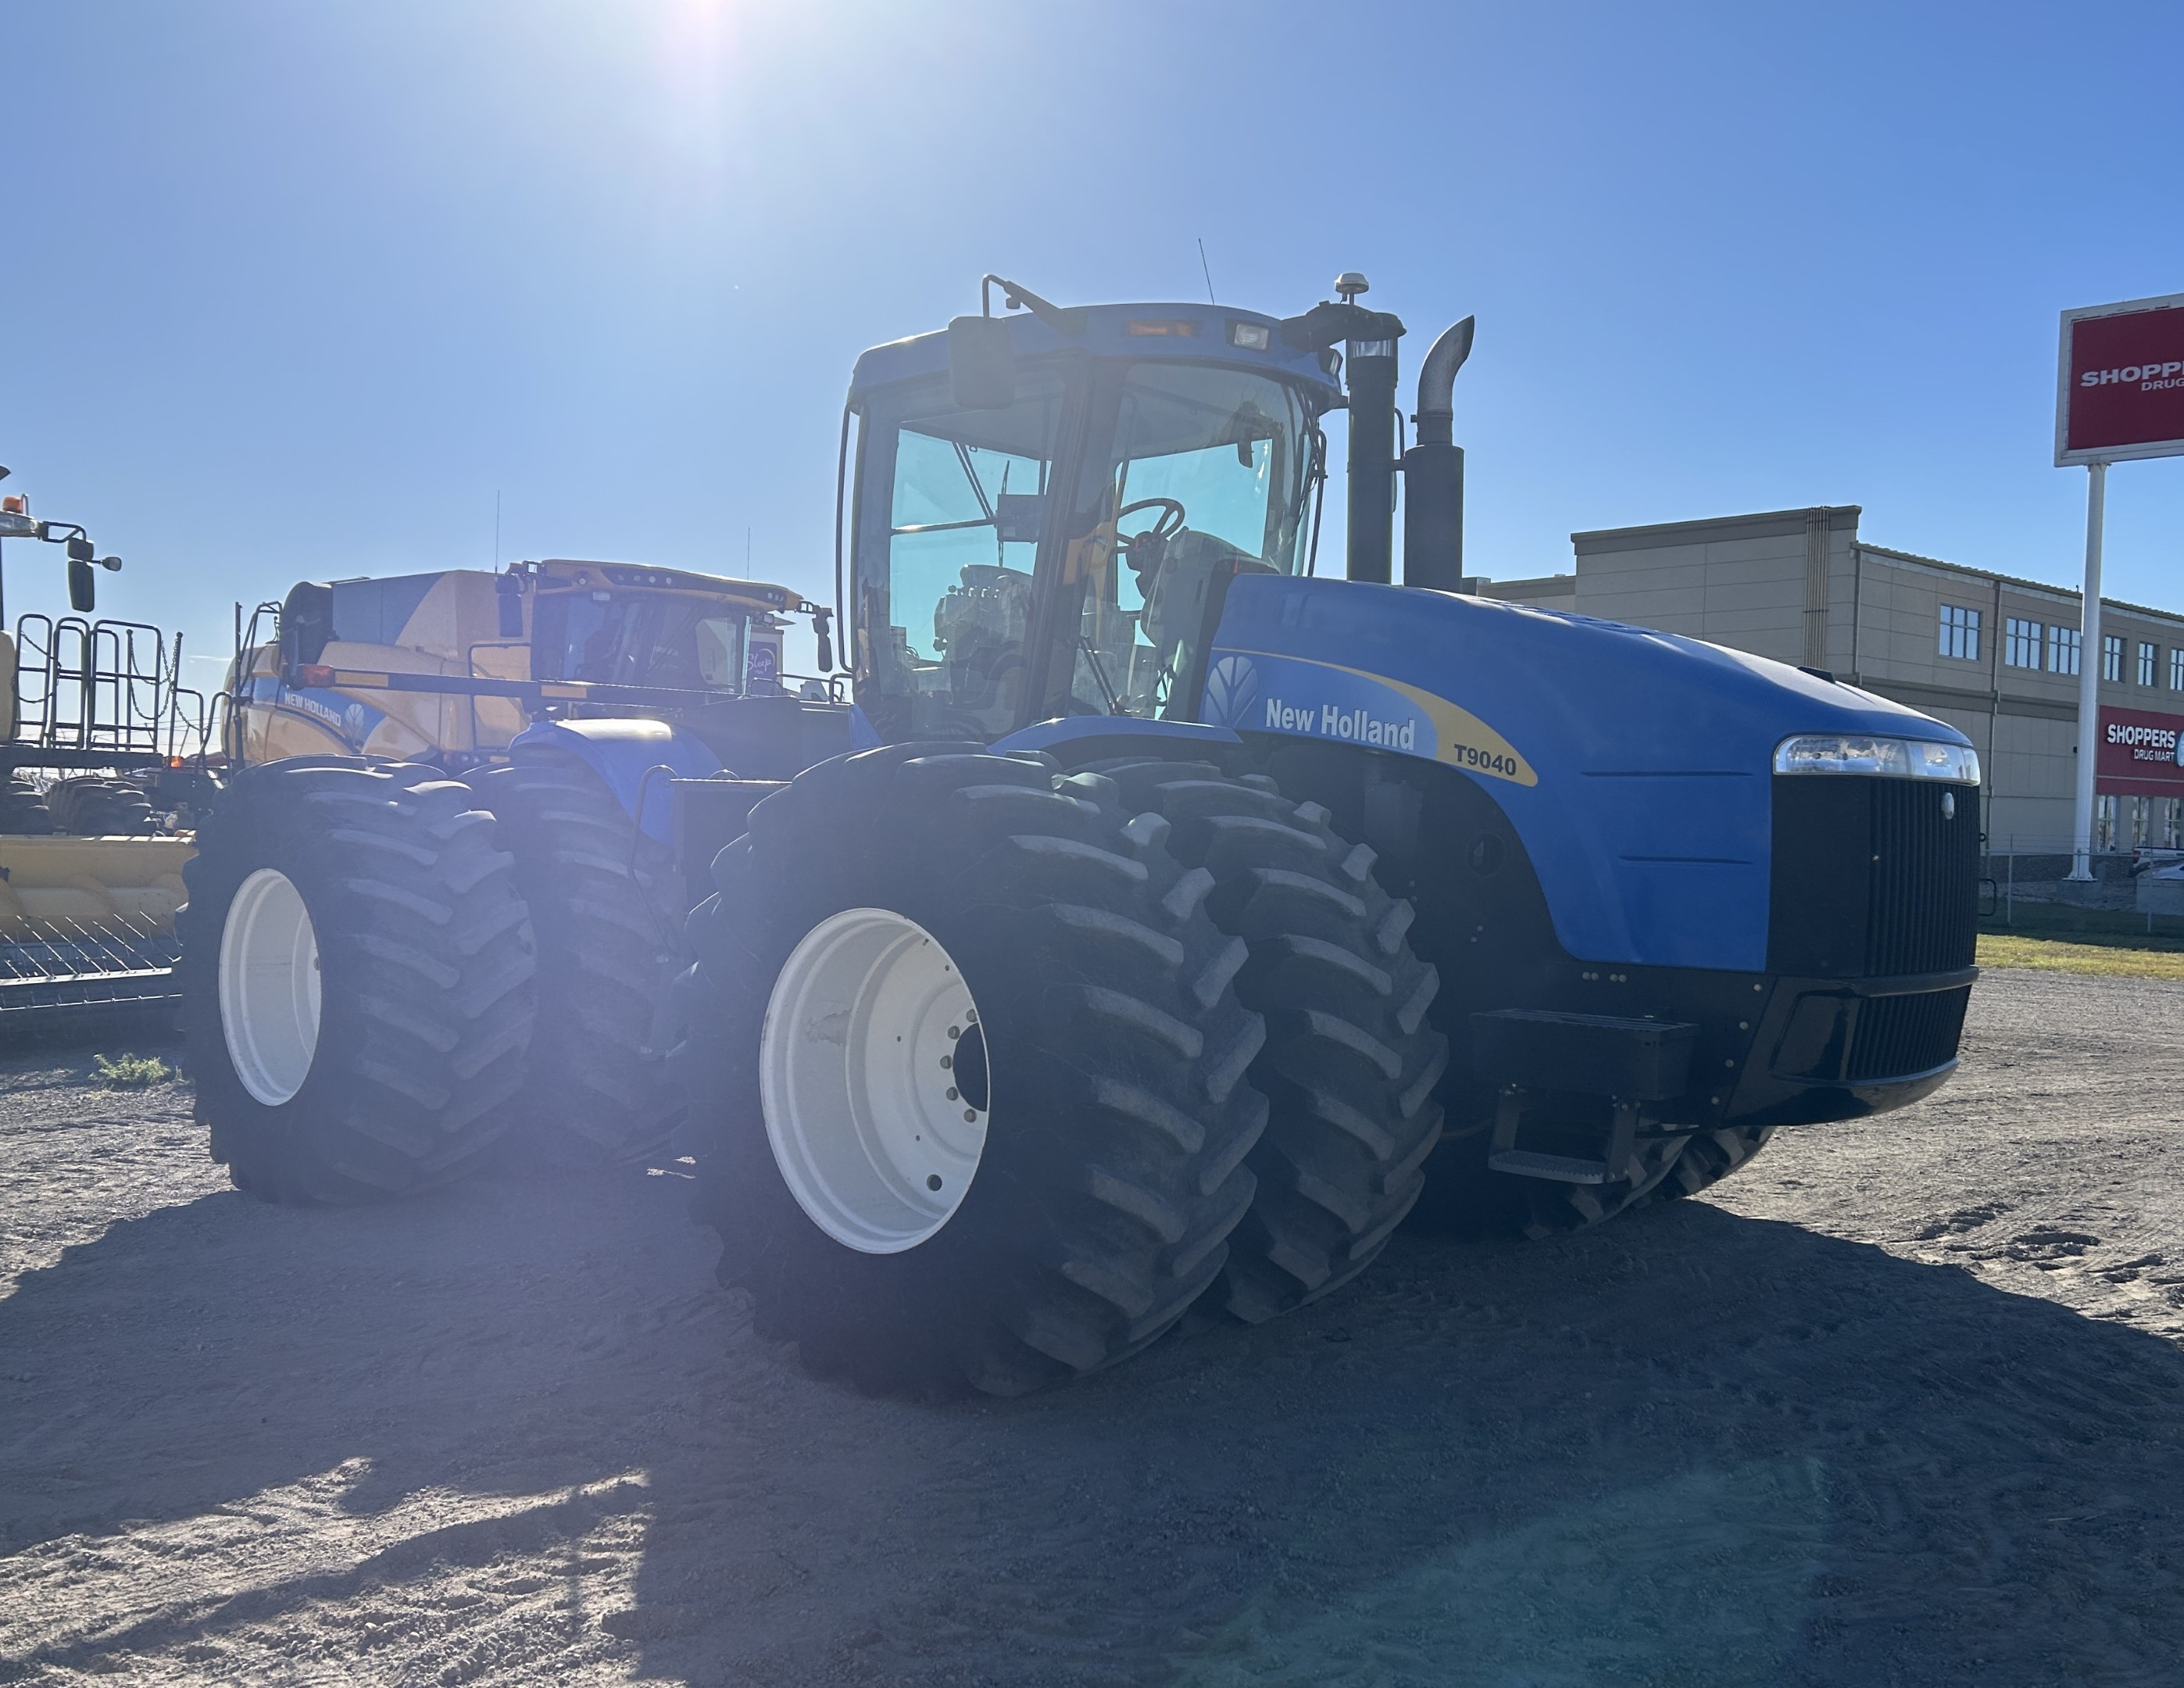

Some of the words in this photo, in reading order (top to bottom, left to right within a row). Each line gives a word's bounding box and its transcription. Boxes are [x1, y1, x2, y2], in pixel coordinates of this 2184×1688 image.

[2080, 361, 2184, 388] SHOPP
[284, 692, 304, 708] NEW
[304, 697, 341, 728] HOLLAND
[1266, 698, 1314, 731] New
[1321, 703, 1416, 751] Holland
[2107, 724, 2176, 749] SHOPPERS
[1453, 743, 1517, 776] T9040
[2134, 749, 2154, 760] DRUG
[2154, 750, 2175, 762] MART
